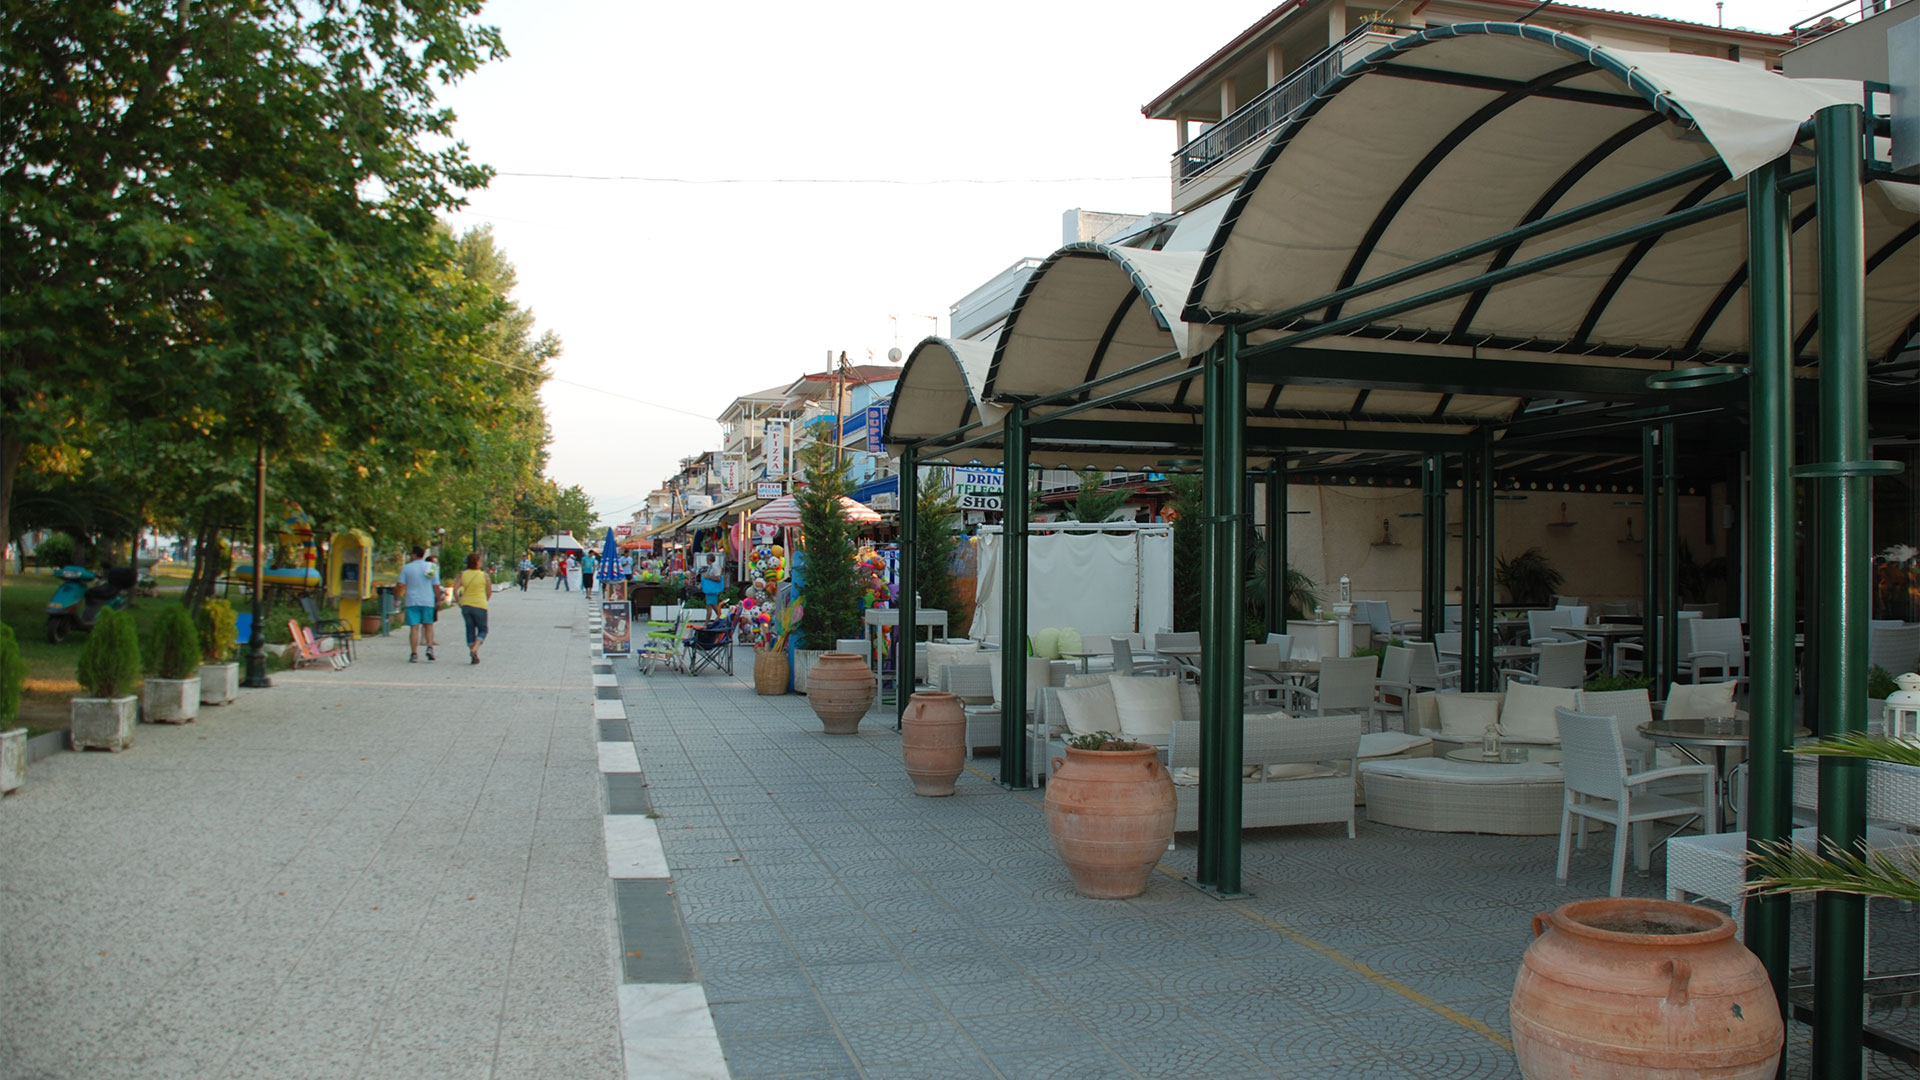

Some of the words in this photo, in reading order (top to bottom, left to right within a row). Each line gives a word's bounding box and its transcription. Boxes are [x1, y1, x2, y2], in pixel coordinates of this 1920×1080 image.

[869, 410, 880, 451] SUPER
[771, 433, 780, 469] PIZZA
[967, 473, 1002, 486] DRIN
[956, 483, 1004, 496] TELECA
[962, 495, 1003, 509] SHO
